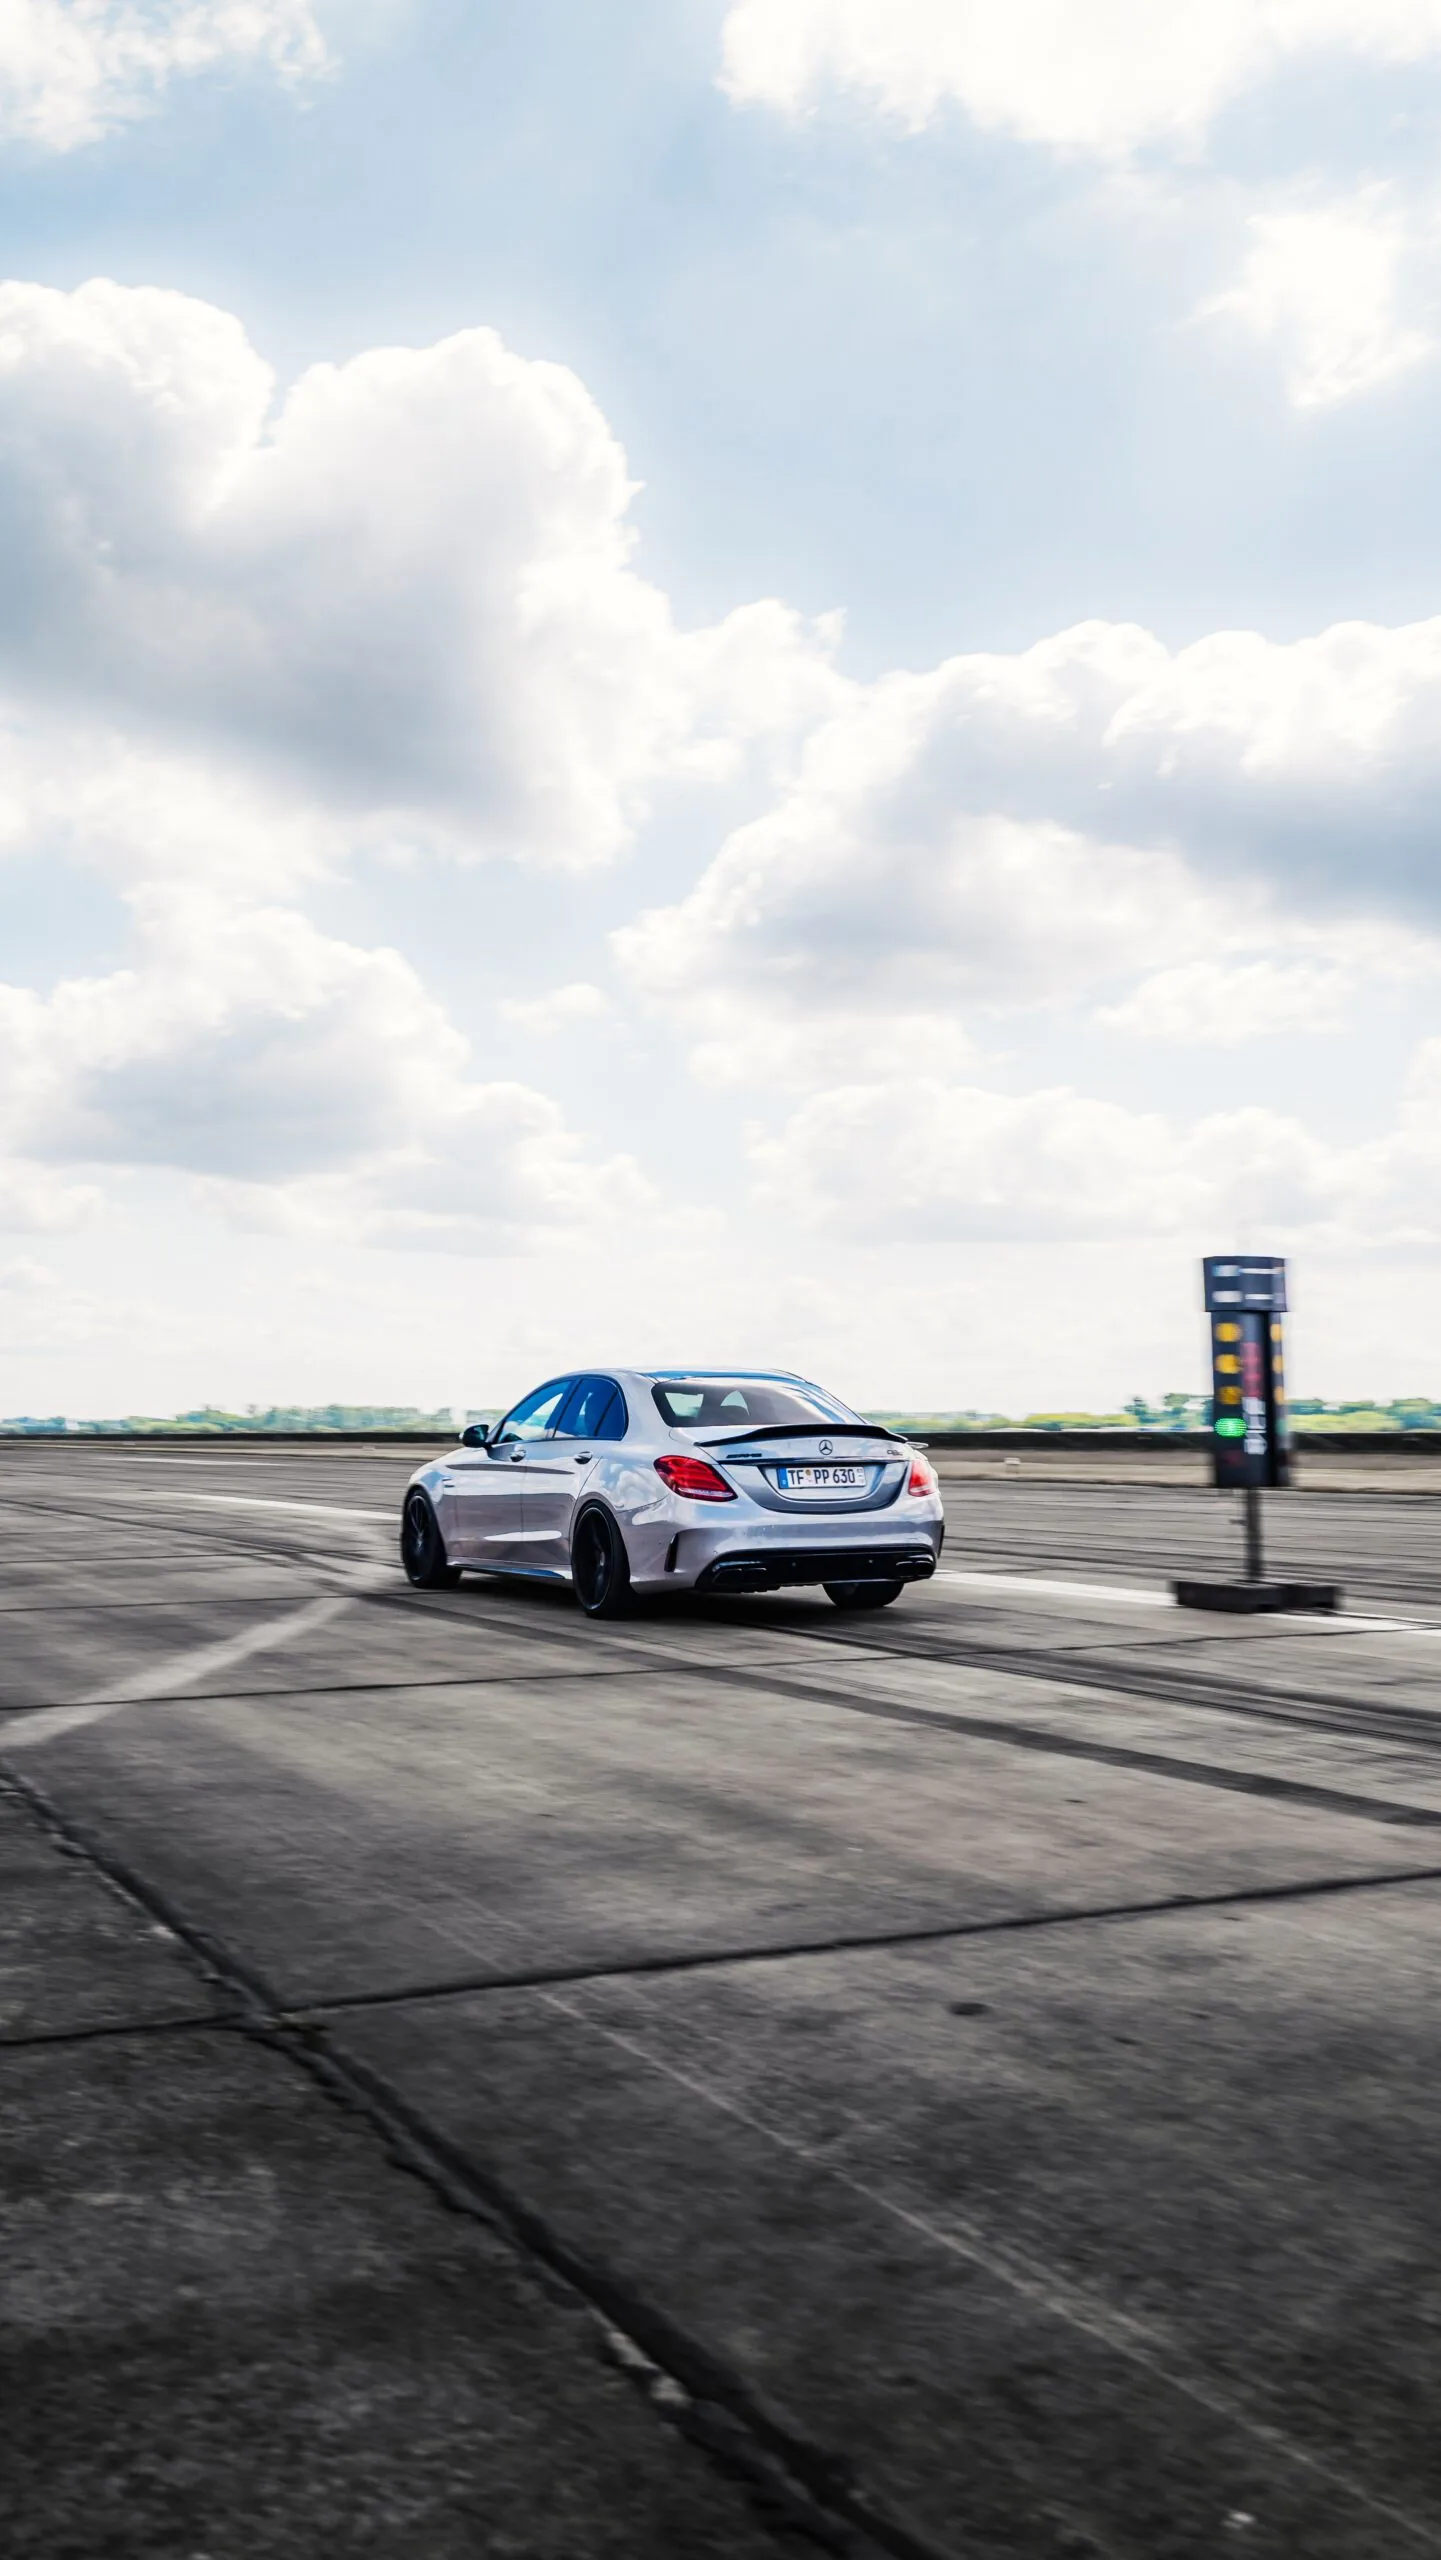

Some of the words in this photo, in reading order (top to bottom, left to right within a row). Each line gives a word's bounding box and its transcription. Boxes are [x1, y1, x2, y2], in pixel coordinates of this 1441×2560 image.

[788, 1469, 804, 1485] TF
[813, 1469, 829, 1484] PP
[833, 1468, 856, 1484] 630
